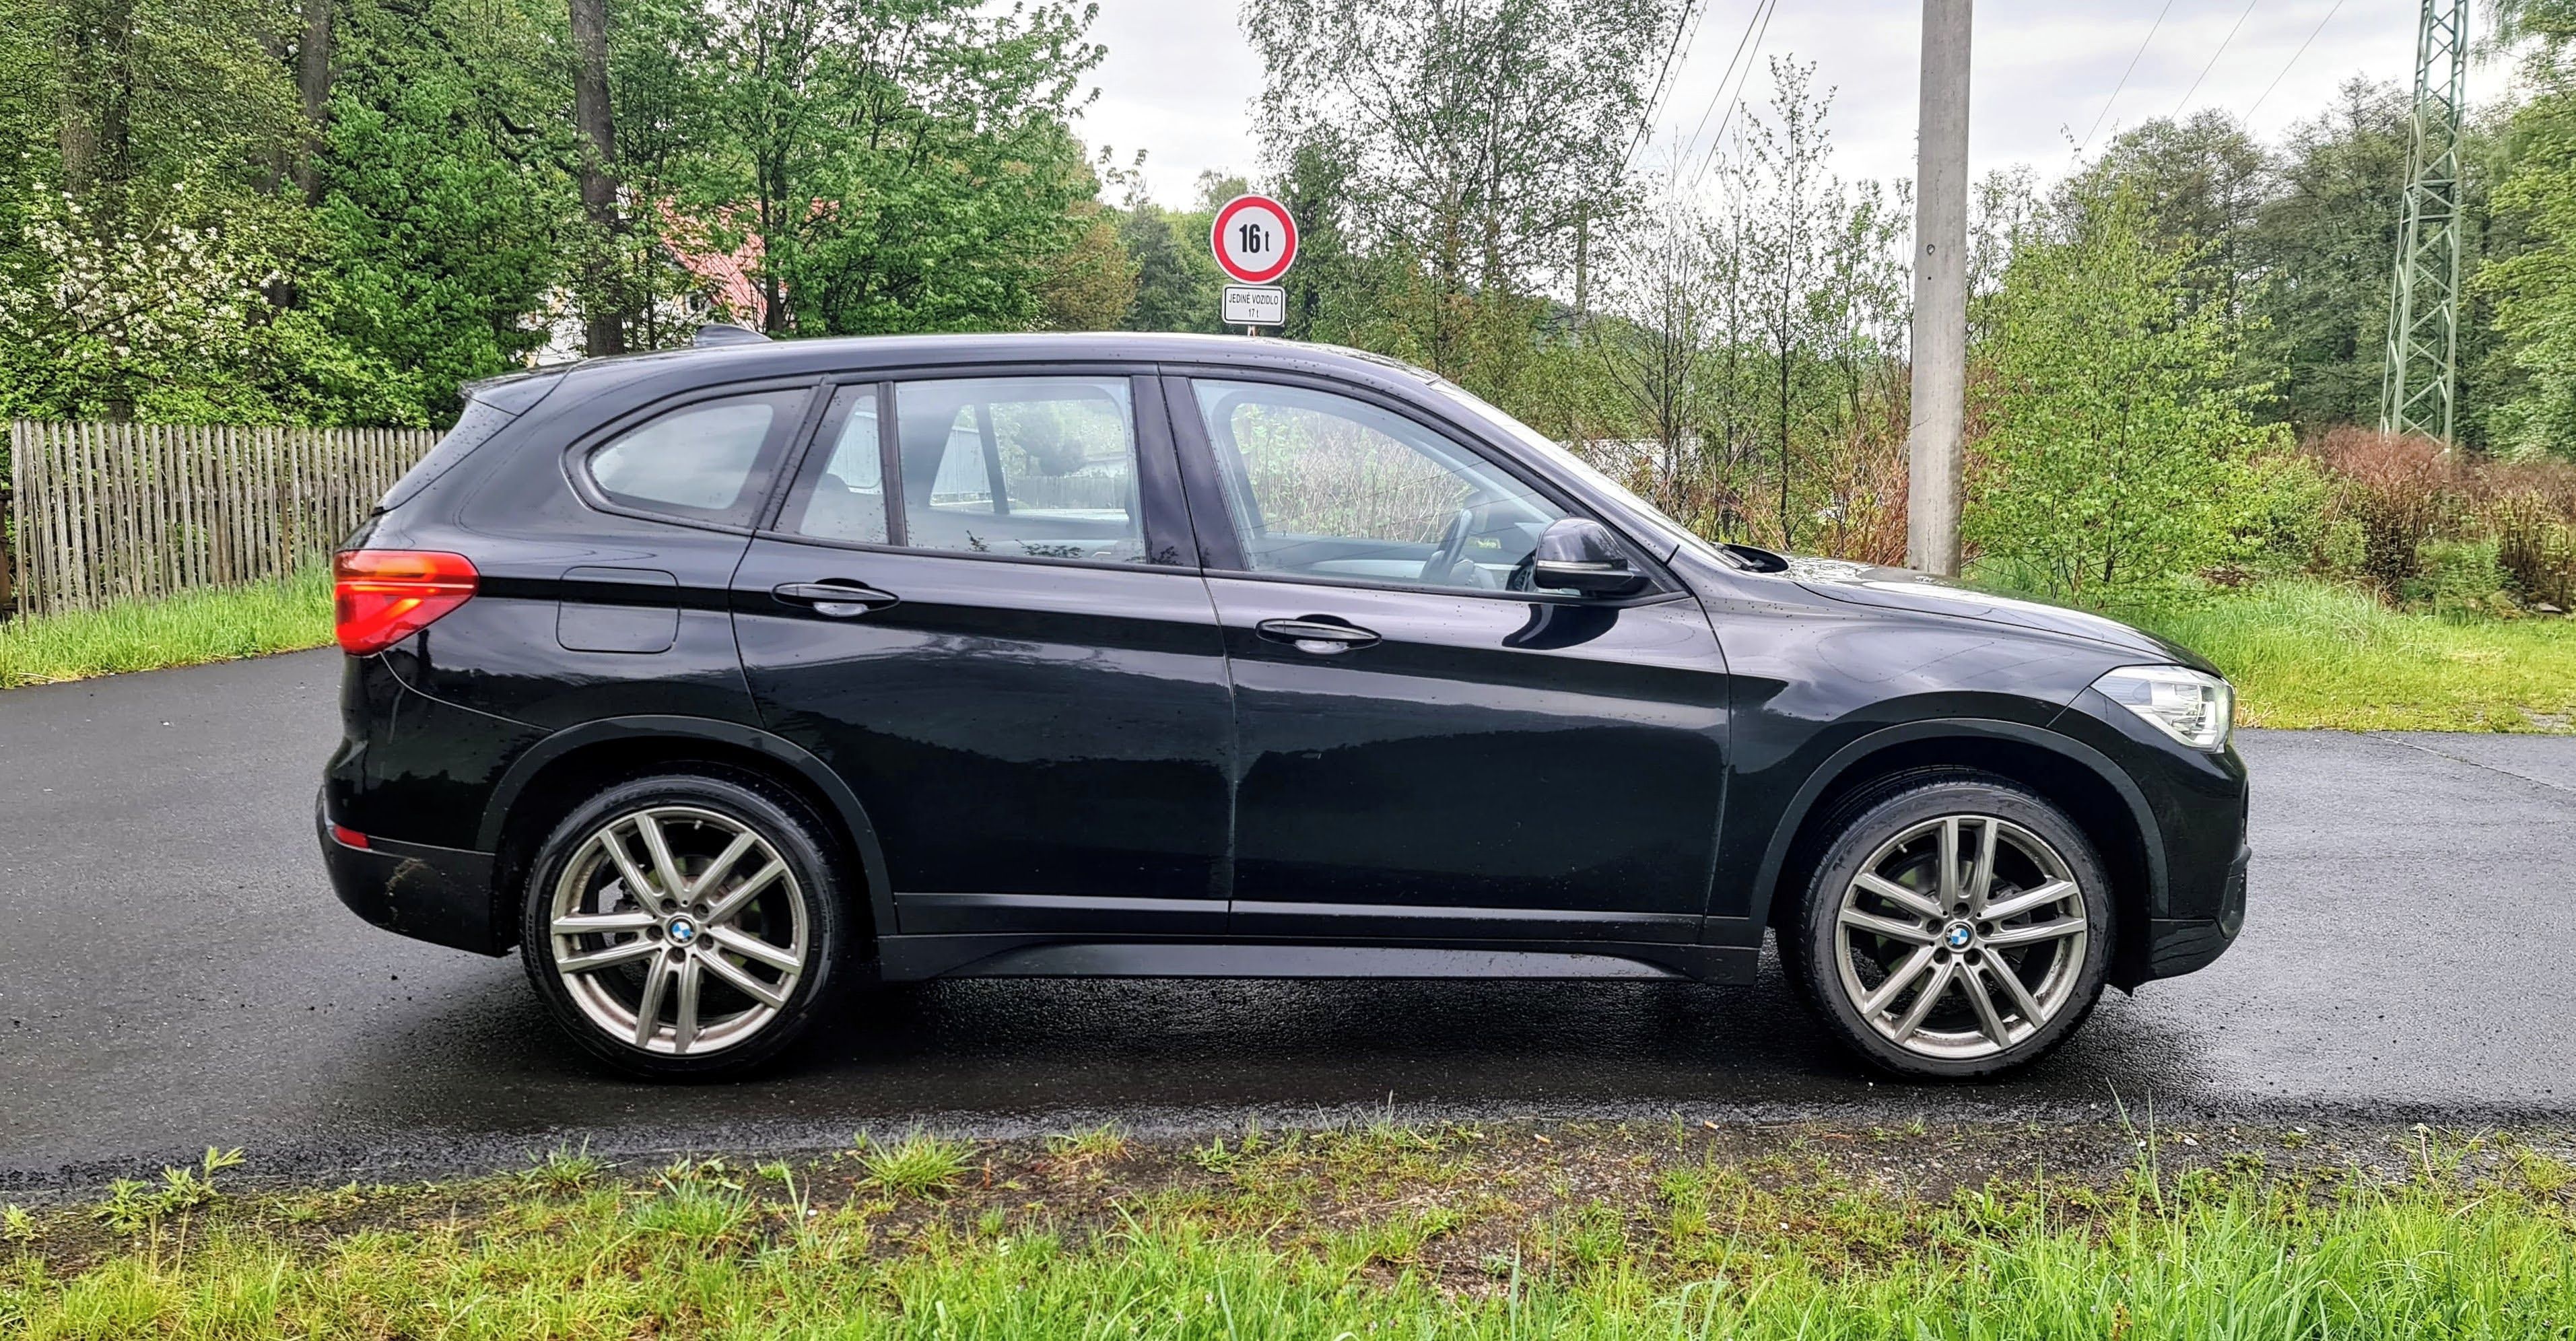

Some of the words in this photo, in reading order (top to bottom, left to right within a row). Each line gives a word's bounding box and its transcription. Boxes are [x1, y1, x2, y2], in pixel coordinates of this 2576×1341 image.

[1239, 224, 1260, 253] 16
[1265, 231, 1269, 252] t
[1229, 292, 1250, 304] JEDINÉ
[1252, 294, 1279, 305] VOZIDLO
[1248, 308, 1255, 318] 17
